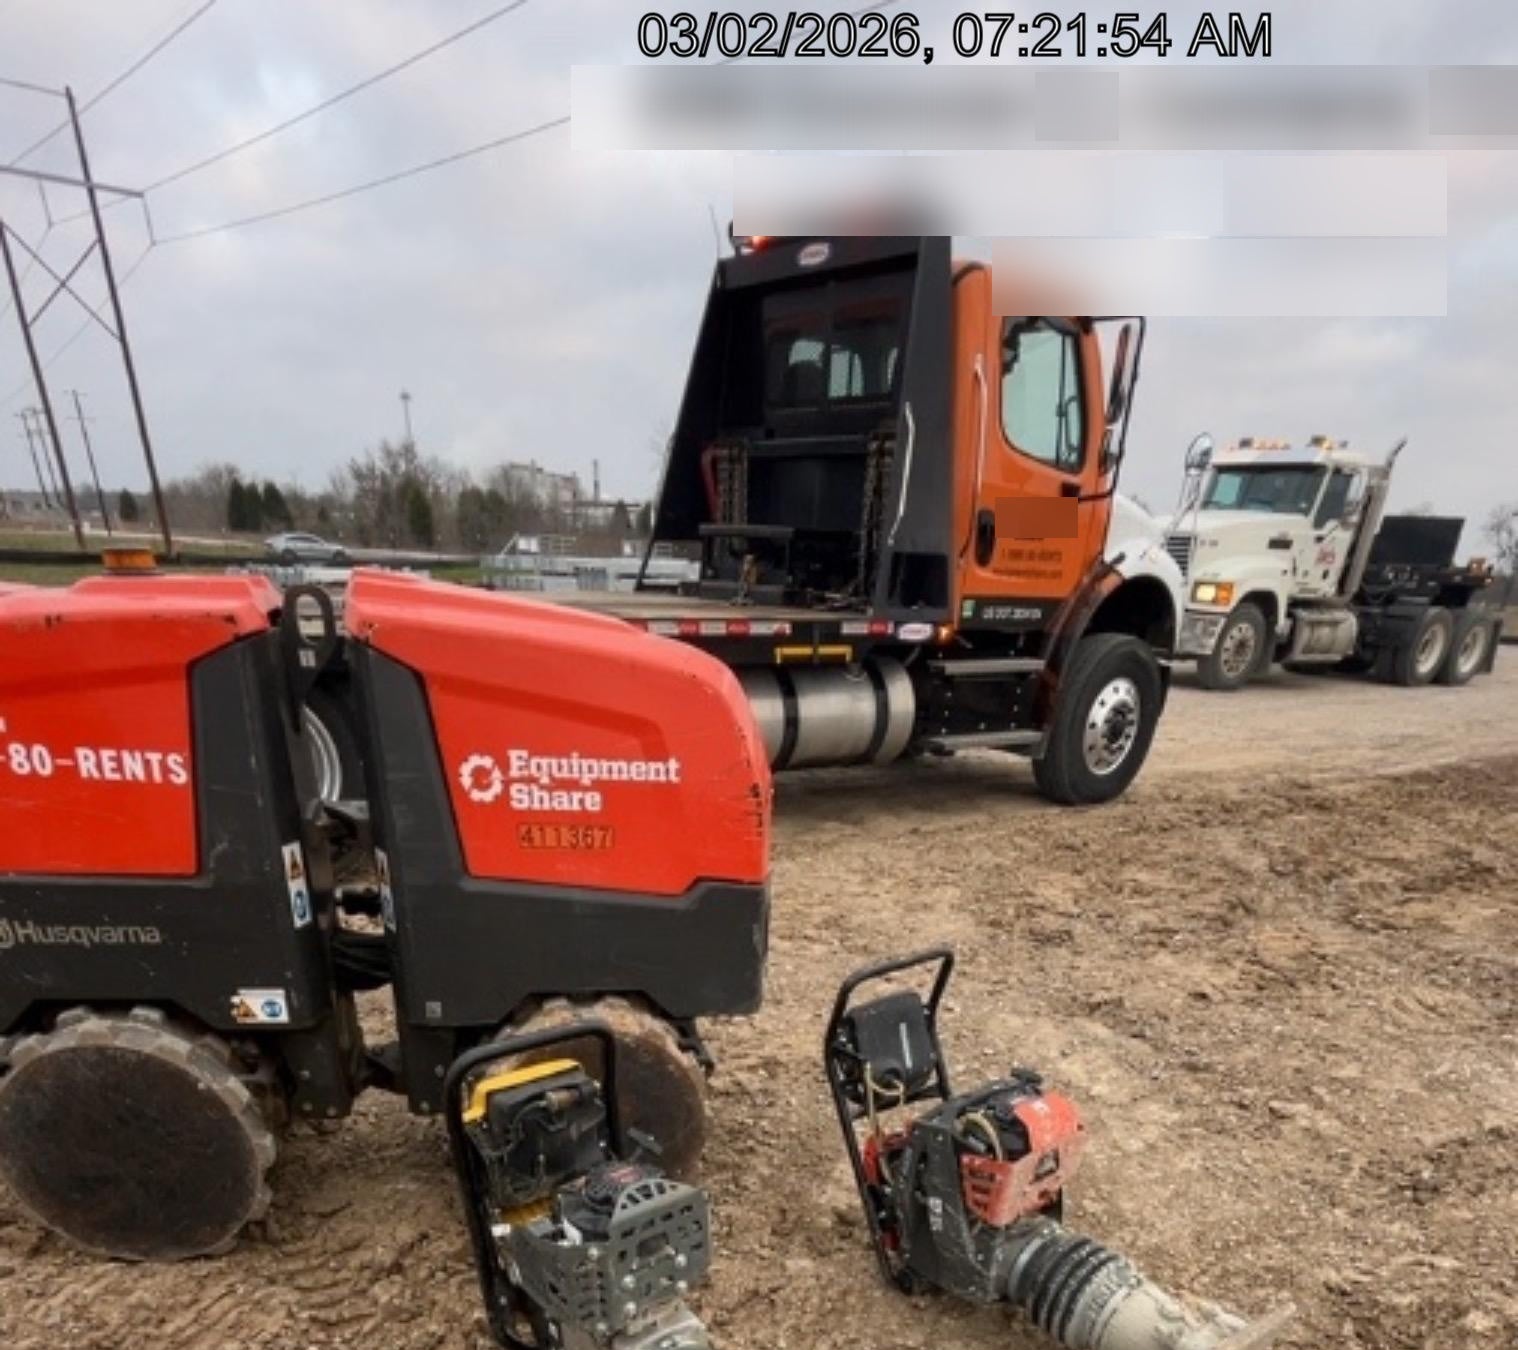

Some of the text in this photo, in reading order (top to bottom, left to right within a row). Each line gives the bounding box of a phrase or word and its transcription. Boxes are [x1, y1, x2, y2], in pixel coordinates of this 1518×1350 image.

[507, 748, 681, 785] Equipment
[509, 782, 602, 811] Share
[13, 920, 161, 948] Husqvarna
